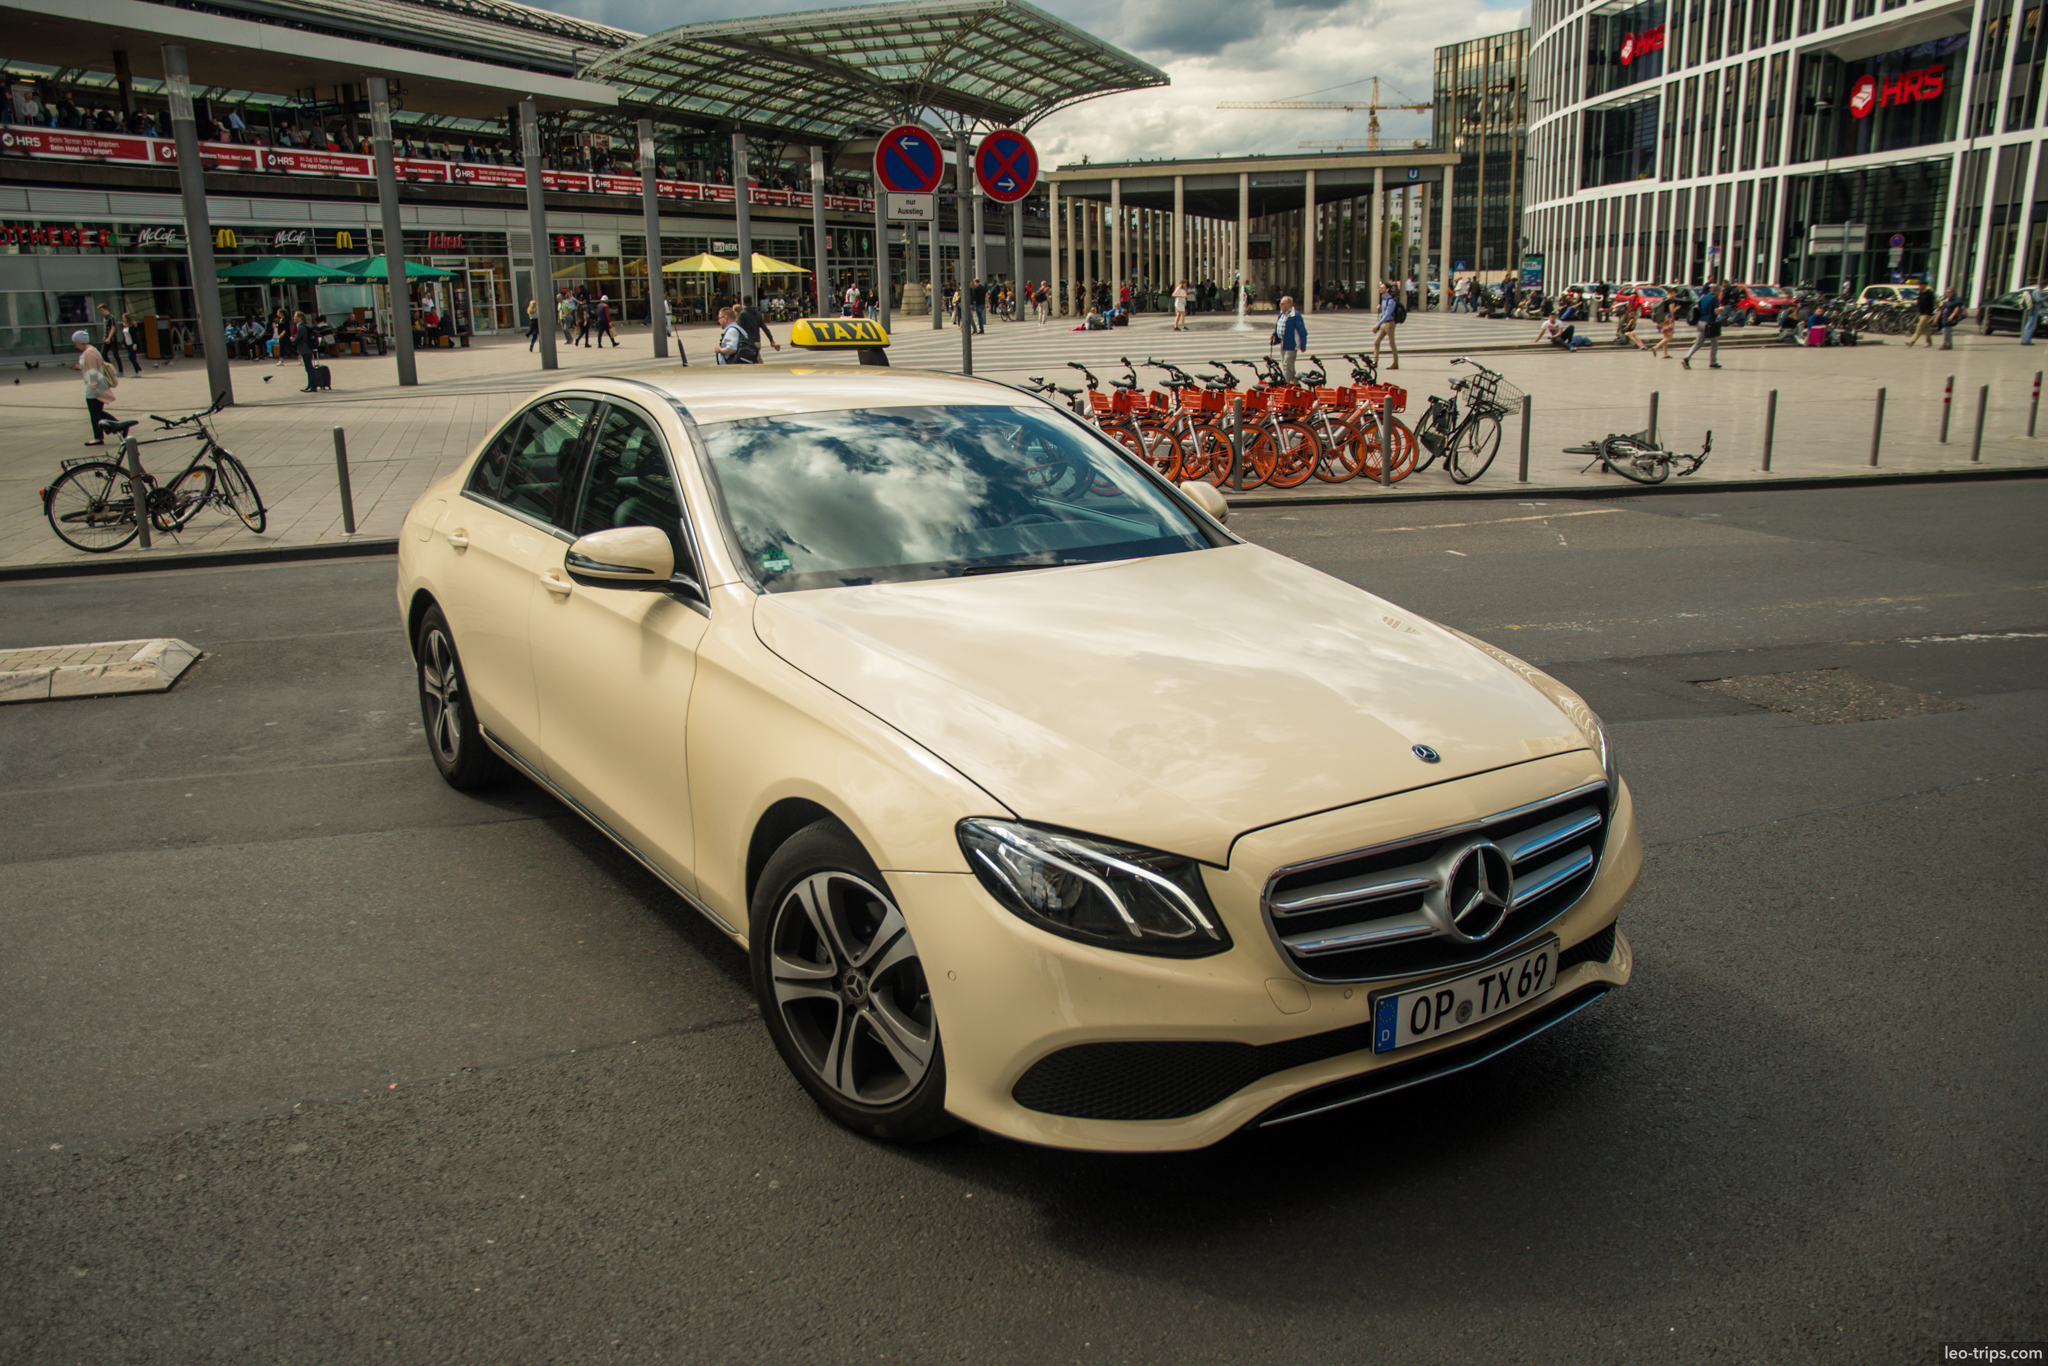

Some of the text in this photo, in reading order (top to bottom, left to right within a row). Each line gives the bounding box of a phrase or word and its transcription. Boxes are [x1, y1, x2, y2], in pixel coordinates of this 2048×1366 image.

[1635, 23, 1665, 57] HRS
[1880, 64, 1946, 108] HRS
[16, 136, 42, 147] HRS
[64, 137, 82, 145] Termin
[65, 145, 80, 153] Hotel
[277, 157, 295, 166] HRS
[897, 207, 923, 216] Ausstieg
[811, 322, 878, 340] TAXI
[1410, 989, 1455, 1036] OP
[1381, 1029, 1390, 1041] D
